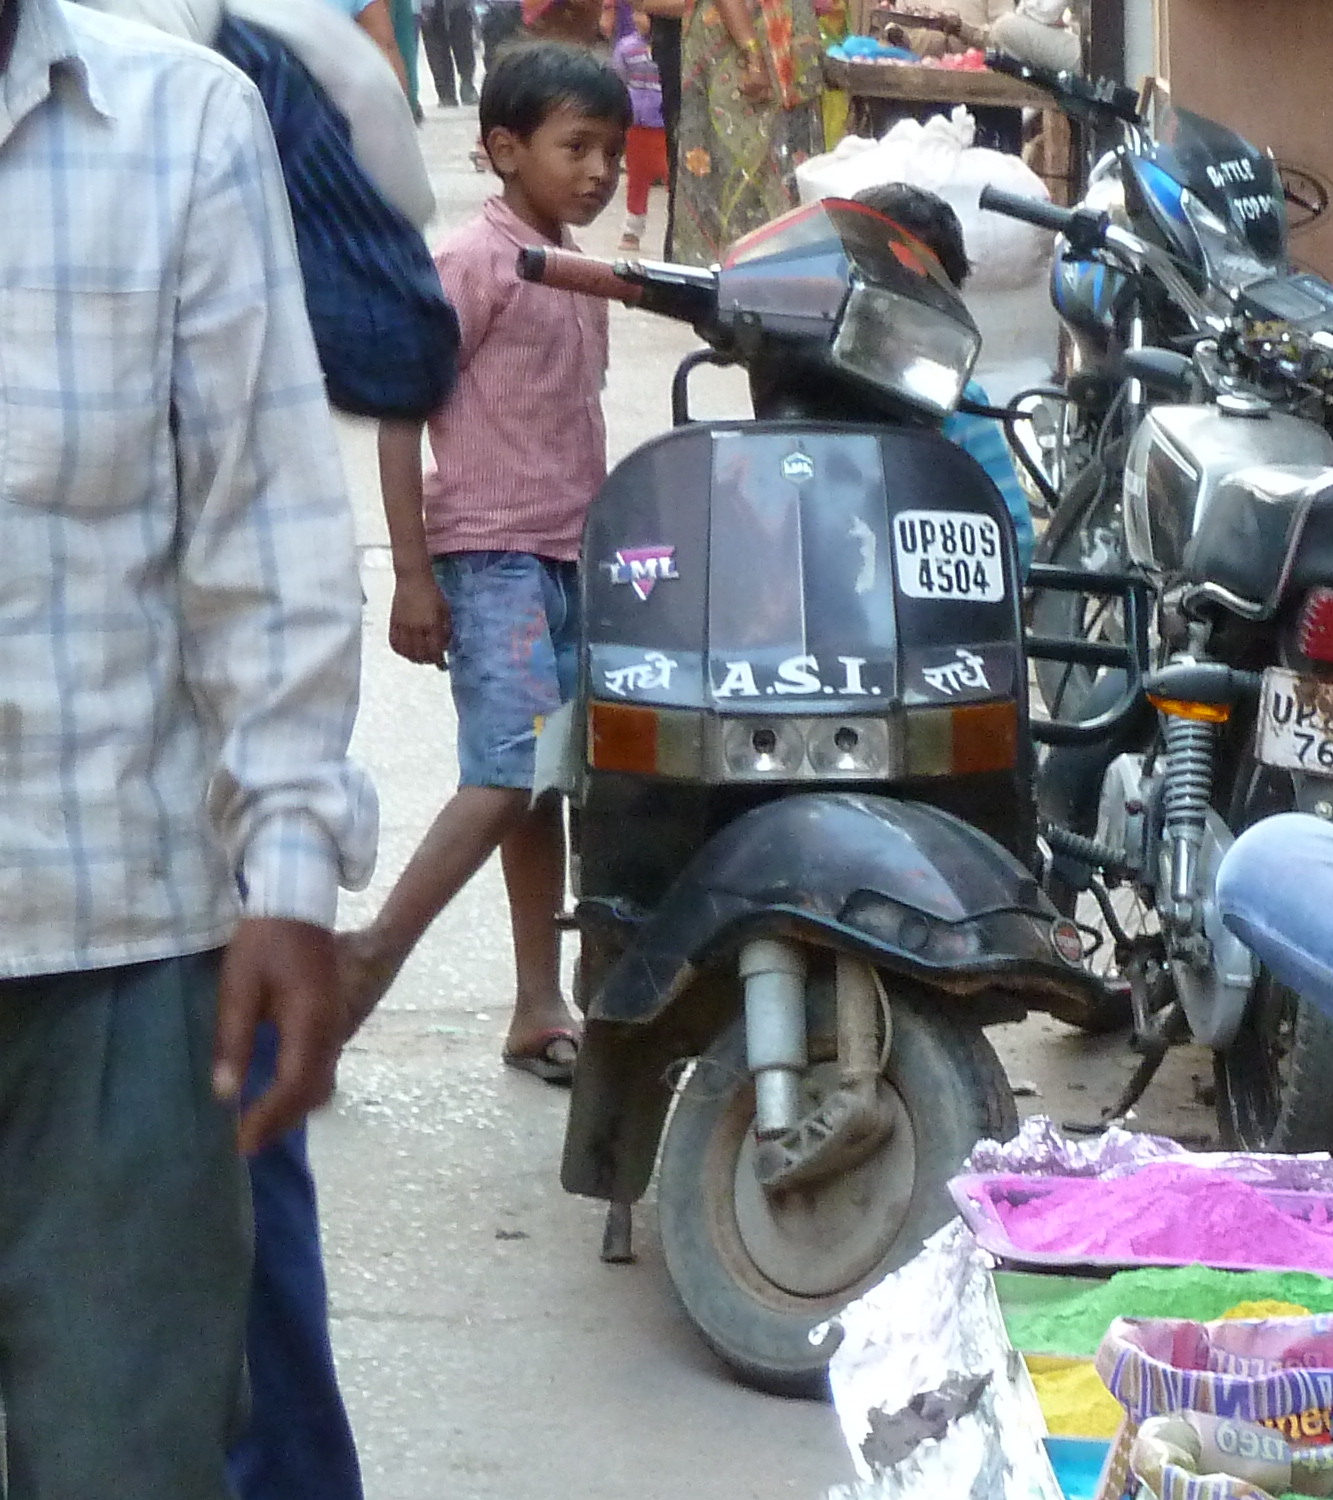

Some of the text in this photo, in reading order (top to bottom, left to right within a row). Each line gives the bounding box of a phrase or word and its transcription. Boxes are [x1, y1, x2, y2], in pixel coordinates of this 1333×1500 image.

[899, 518, 997, 556] UP80S
[611, 561, 679, 584] LML
[918, 557, 991, 595] 4504
[605, 650, 677, 696] राधे
[711, 654, 881, 697] A.S.I.
[922, 649, 993, 696] राधे
